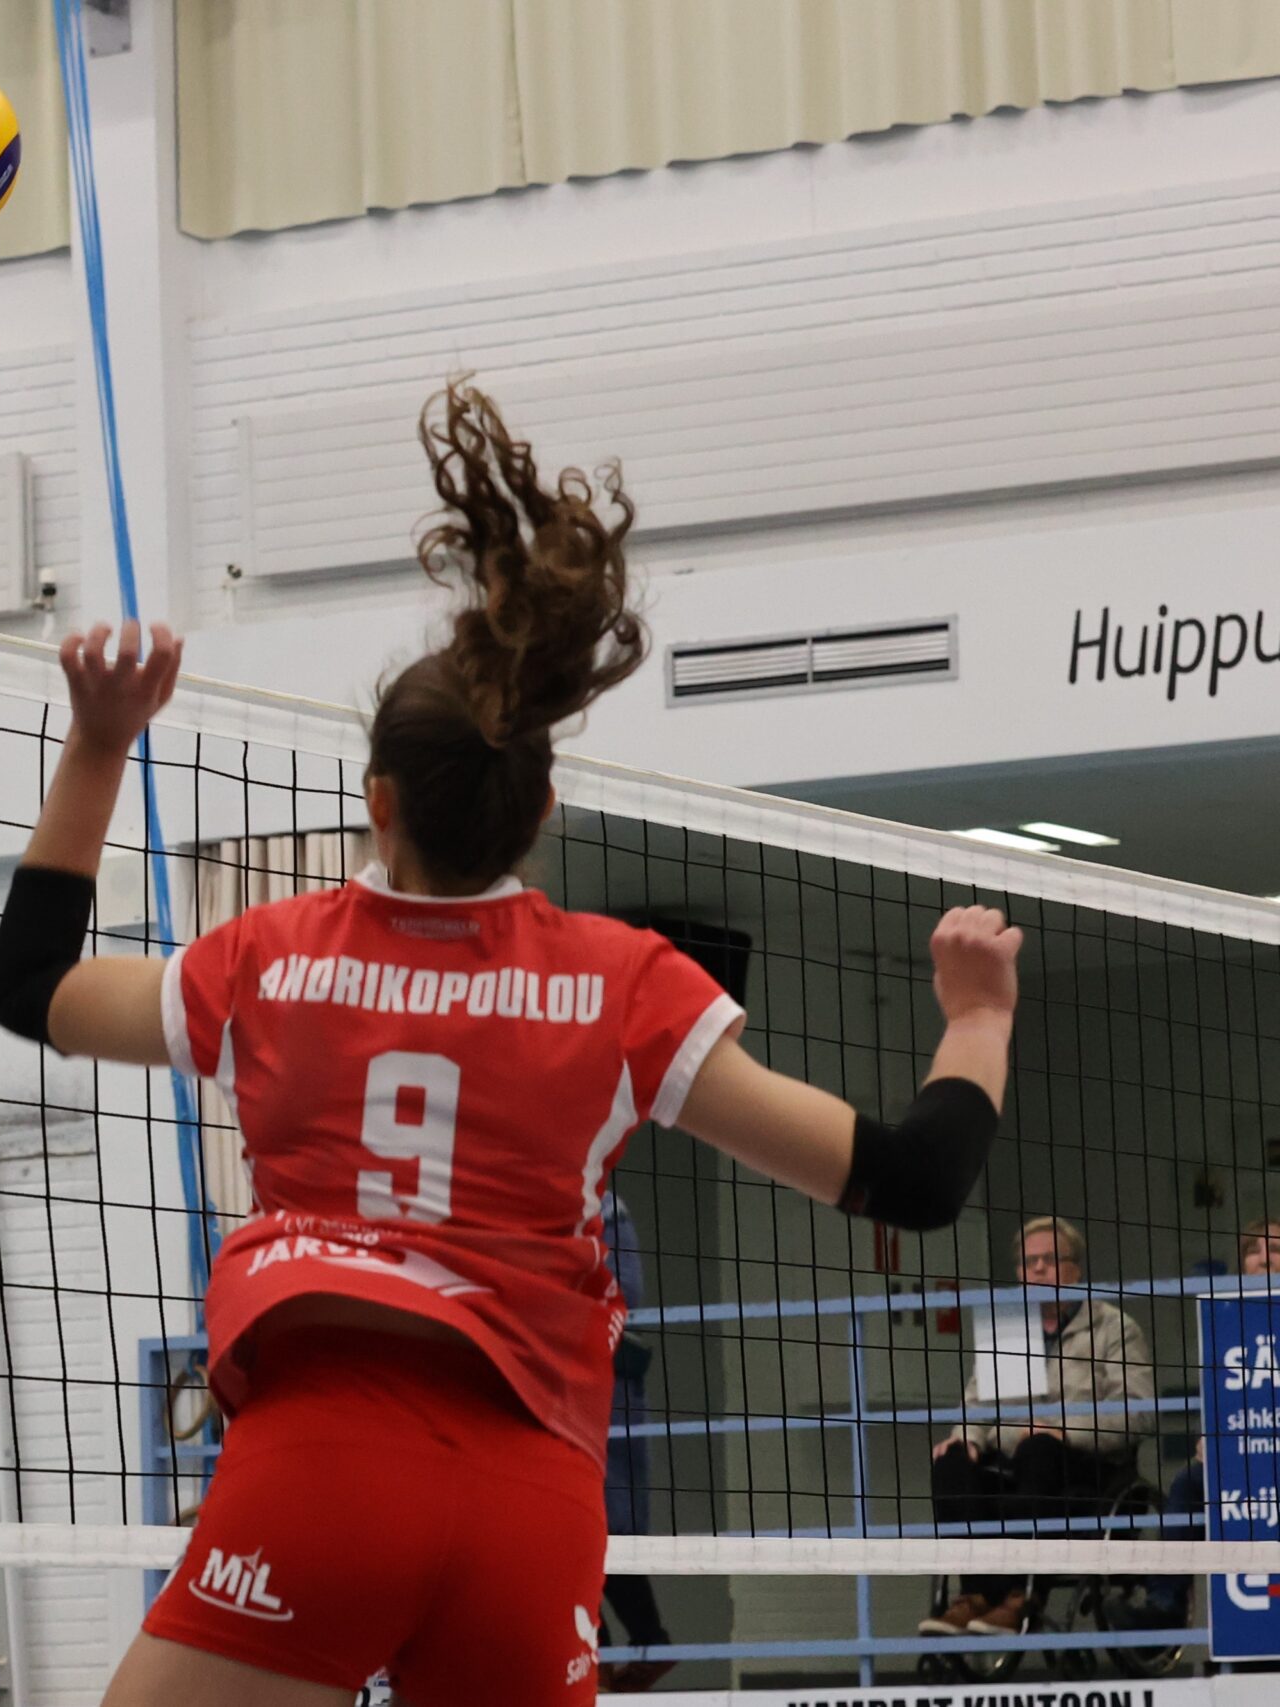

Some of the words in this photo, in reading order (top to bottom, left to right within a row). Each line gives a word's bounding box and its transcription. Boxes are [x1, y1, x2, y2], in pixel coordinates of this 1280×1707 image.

[1068, 604, 1280, 702] Huippu
[258, 953, 604, 1025] ANDRIKOPOULOU
[356, 1050, 461, 1225] 9
[1220, 1486, 1280, 1528] Keij
